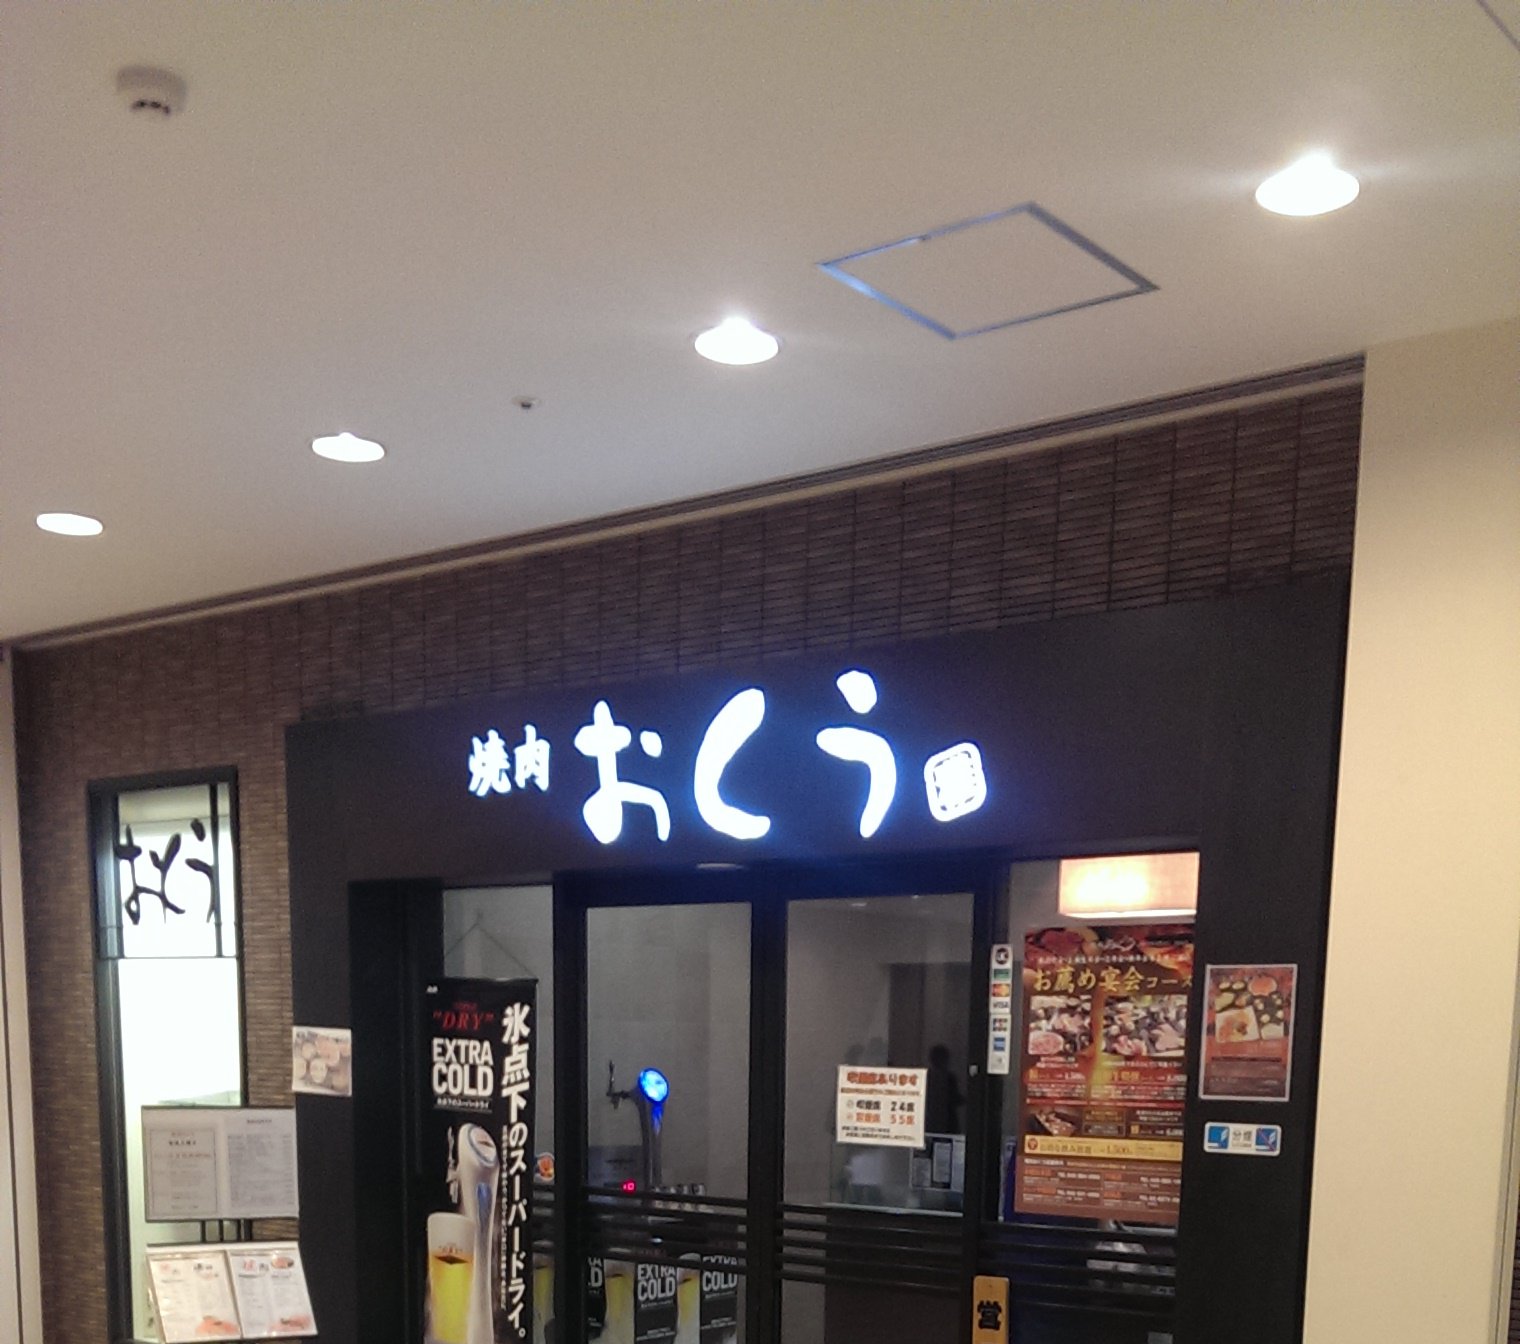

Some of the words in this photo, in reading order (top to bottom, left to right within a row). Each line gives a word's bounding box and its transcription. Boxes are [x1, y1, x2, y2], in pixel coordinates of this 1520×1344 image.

[468, 724, 551, 796] 焼肉
[574, 670, 896, 844] おくう
[432, 1037, 494, 1065] EXTRA
[432, 1062, 494, 1097] COLD
[501, 1002, 531, 1339] 氷点下のスーパードライ。
[637, 1277, 677, 1301] COLD
[702, 1271, 738, 1292] COLD
